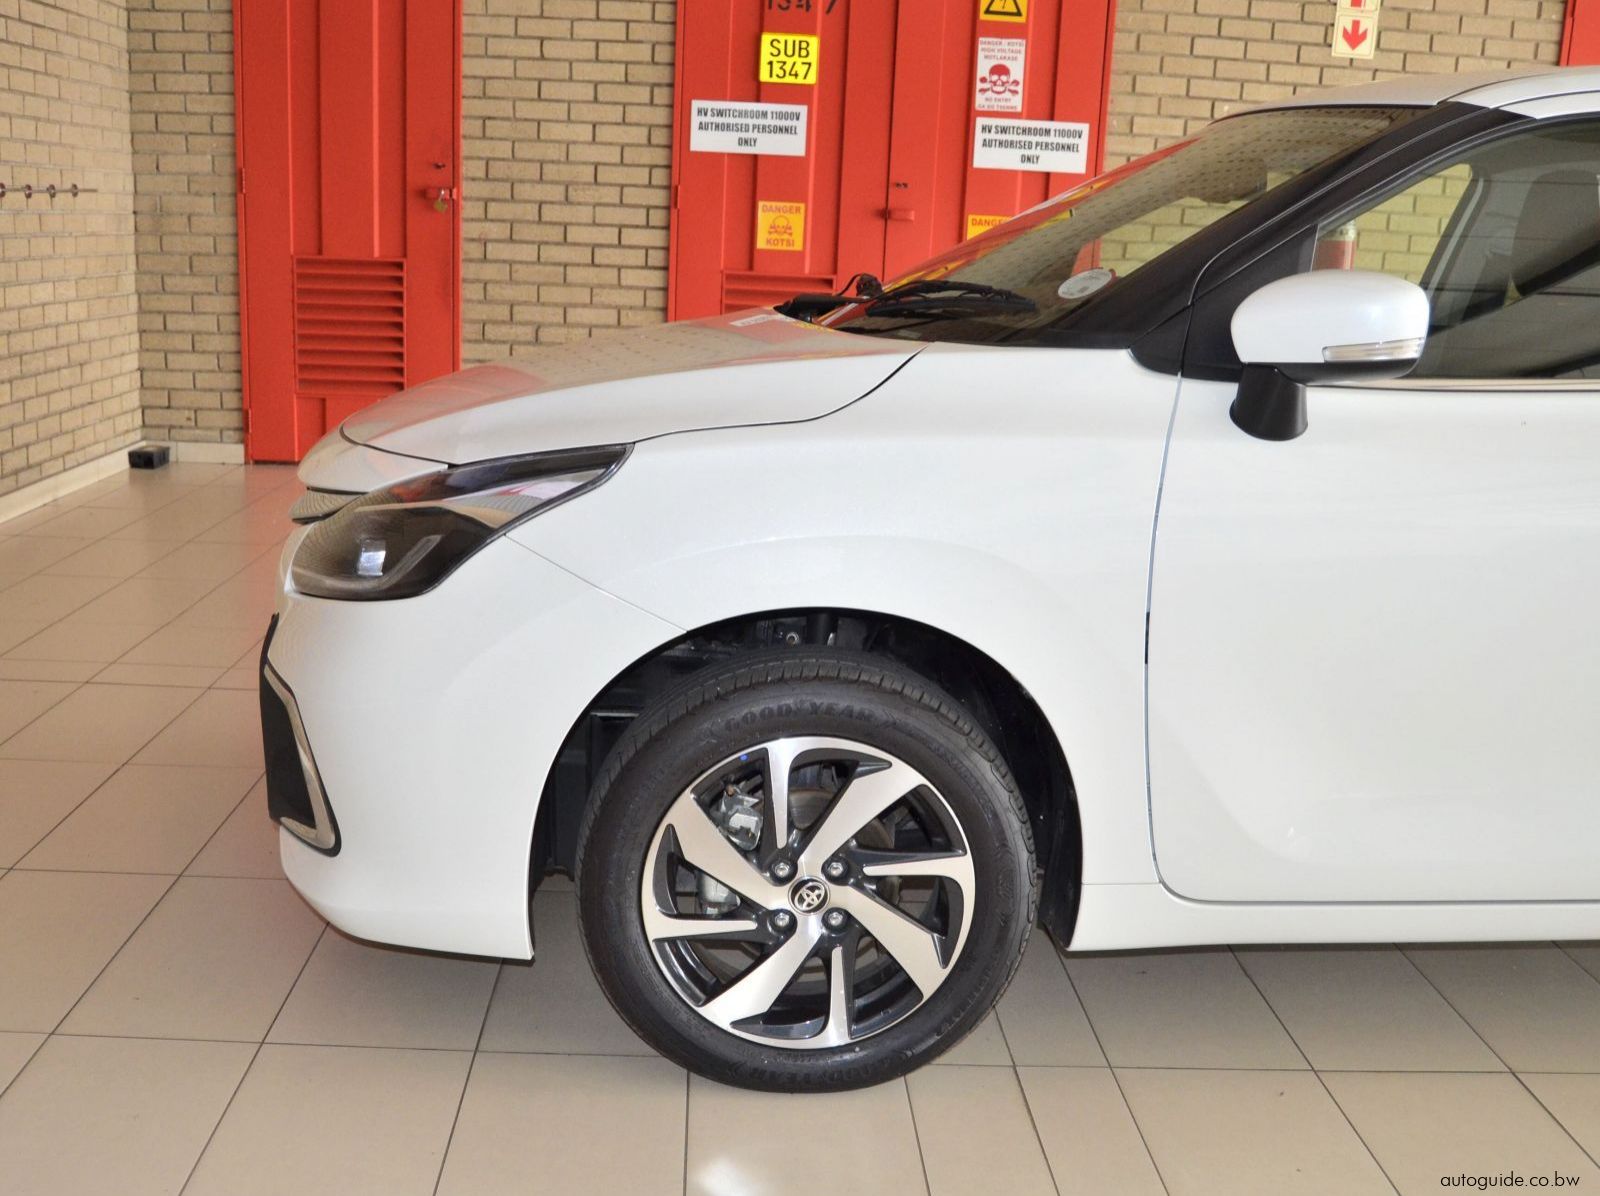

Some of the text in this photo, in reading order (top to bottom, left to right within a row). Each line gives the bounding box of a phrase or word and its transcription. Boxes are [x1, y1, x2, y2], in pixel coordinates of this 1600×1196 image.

[769, 38, 811, 59] SUB
[767, 60, 812, 80] 1347
[697, 107, 801, 121] HV SWITCHROOM 11000V
[698, 121, 798, 135] AUTHORISED PERSONNEL
[981, 124, 1083, 139] HV SWITCHROOM 11000V
[737, 137, 758, 147] ONLY
[982, 138, 1080, 153] AUTHORISED PERSONNEL
[1020, 153, 1040, 165] ONLY
[761, 203, 802, 214] DANGER
[971, 217, 1002, 227] DANG
[766, 237, 796, 248] KOTSI
